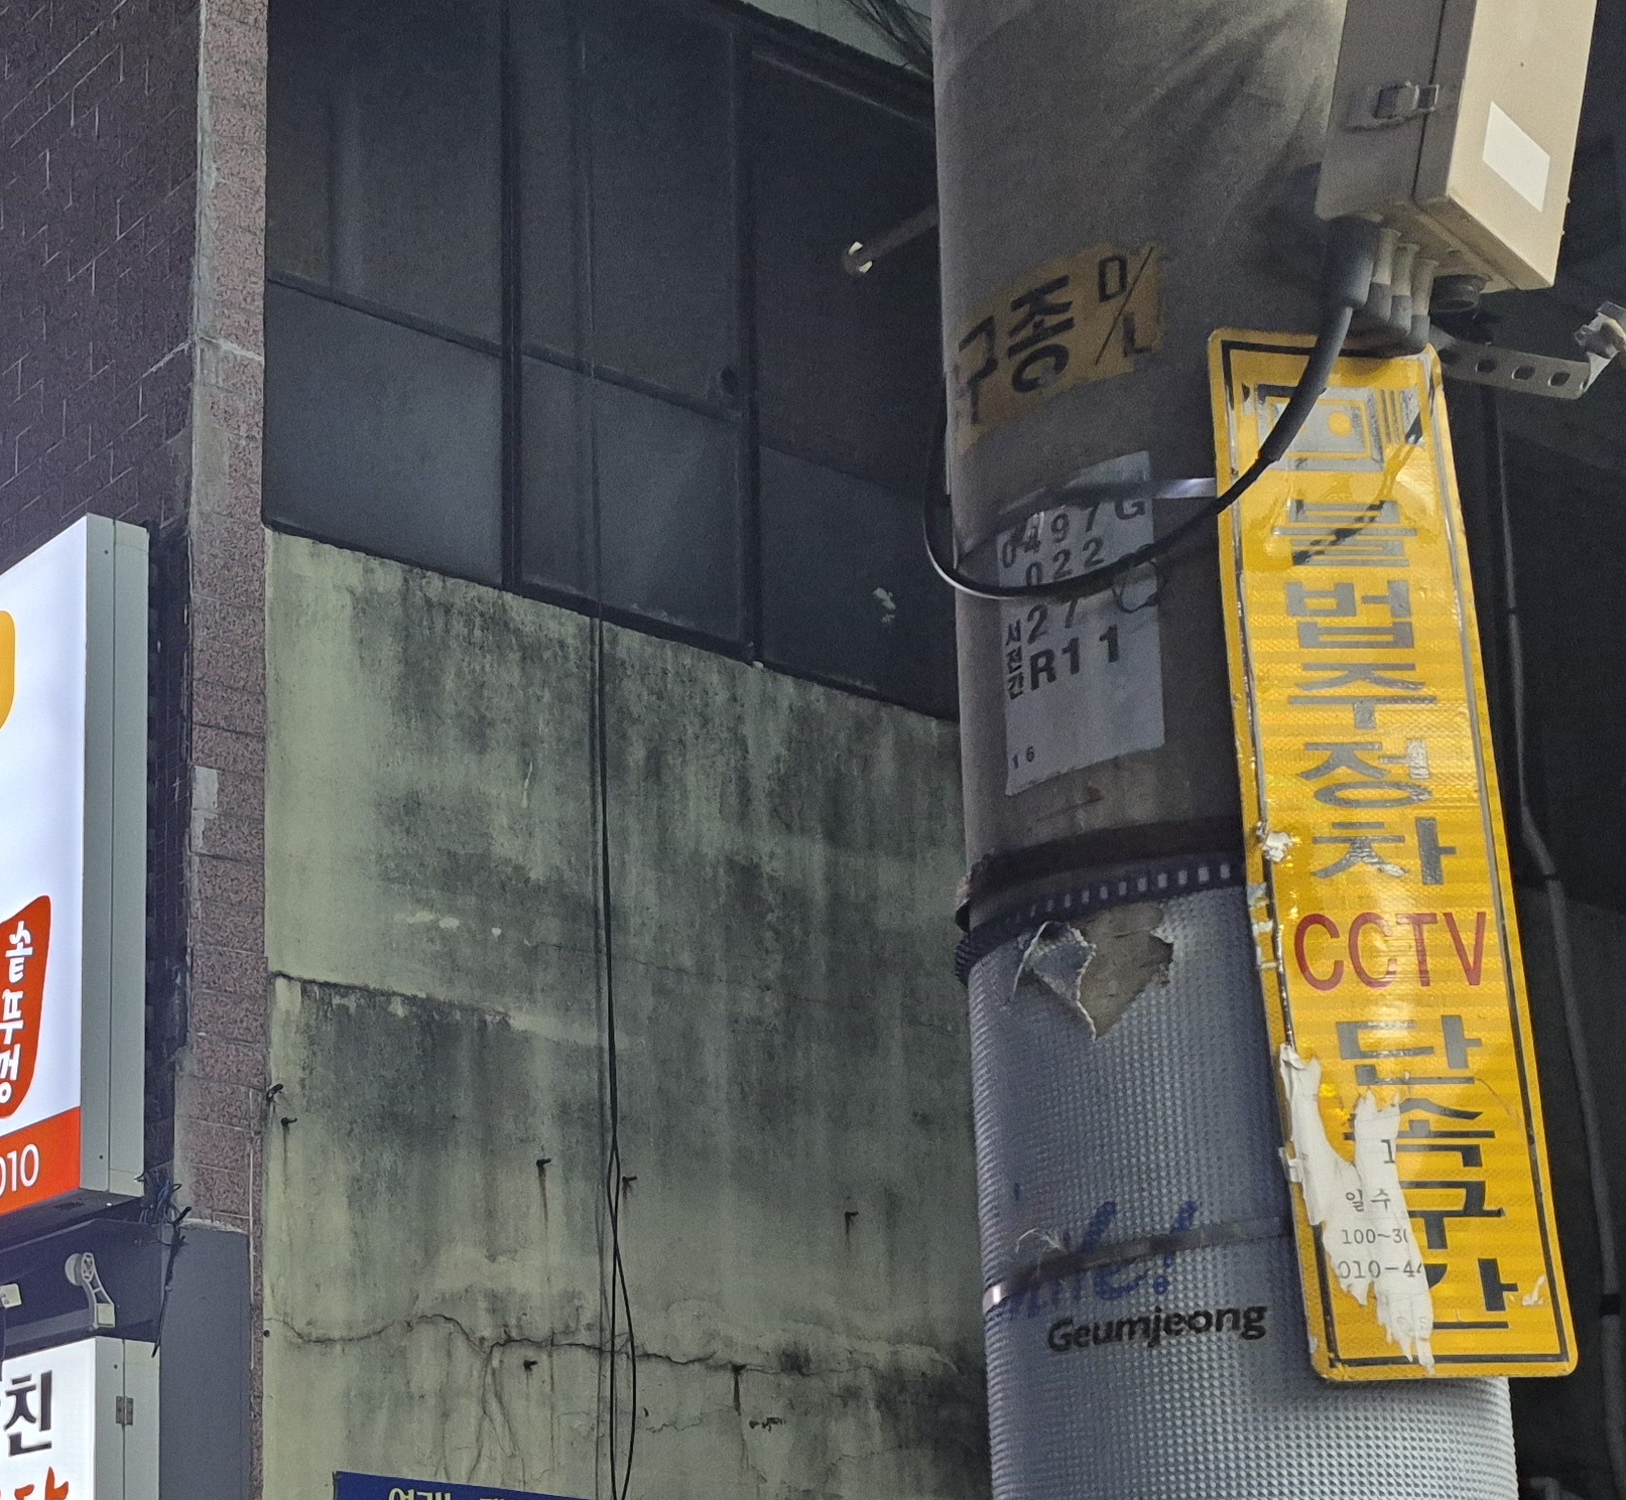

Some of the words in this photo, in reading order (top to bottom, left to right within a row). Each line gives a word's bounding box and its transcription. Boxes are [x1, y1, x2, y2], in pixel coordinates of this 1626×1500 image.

[1026, 537, 1105, 586] 022
[1271, 498, 1456, 885] 불법주정차
[1294, 911, 1486, 991] CCTV
[1047, 1305, 1269, 1353] Geumjeong
